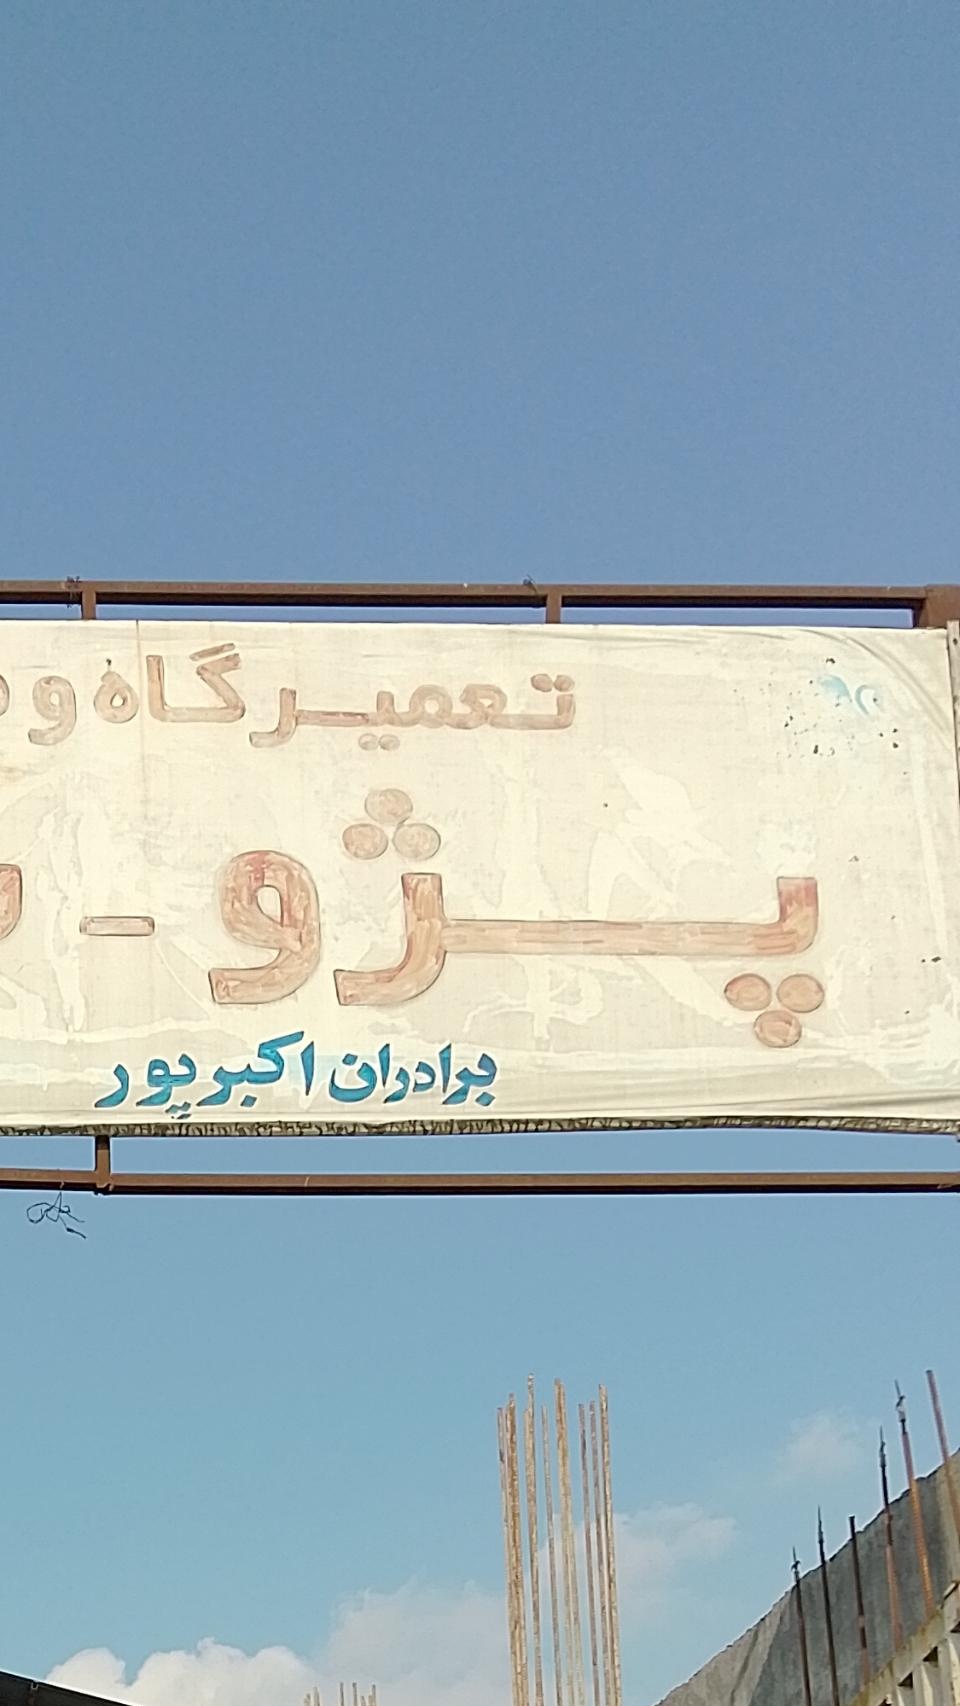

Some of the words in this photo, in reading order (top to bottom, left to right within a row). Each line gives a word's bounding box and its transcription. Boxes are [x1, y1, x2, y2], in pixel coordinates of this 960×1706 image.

[27, 674, 77, 746] و
[208, 787, 827, 1048] پژو
[328, 1042, 498, 1107] برادران
